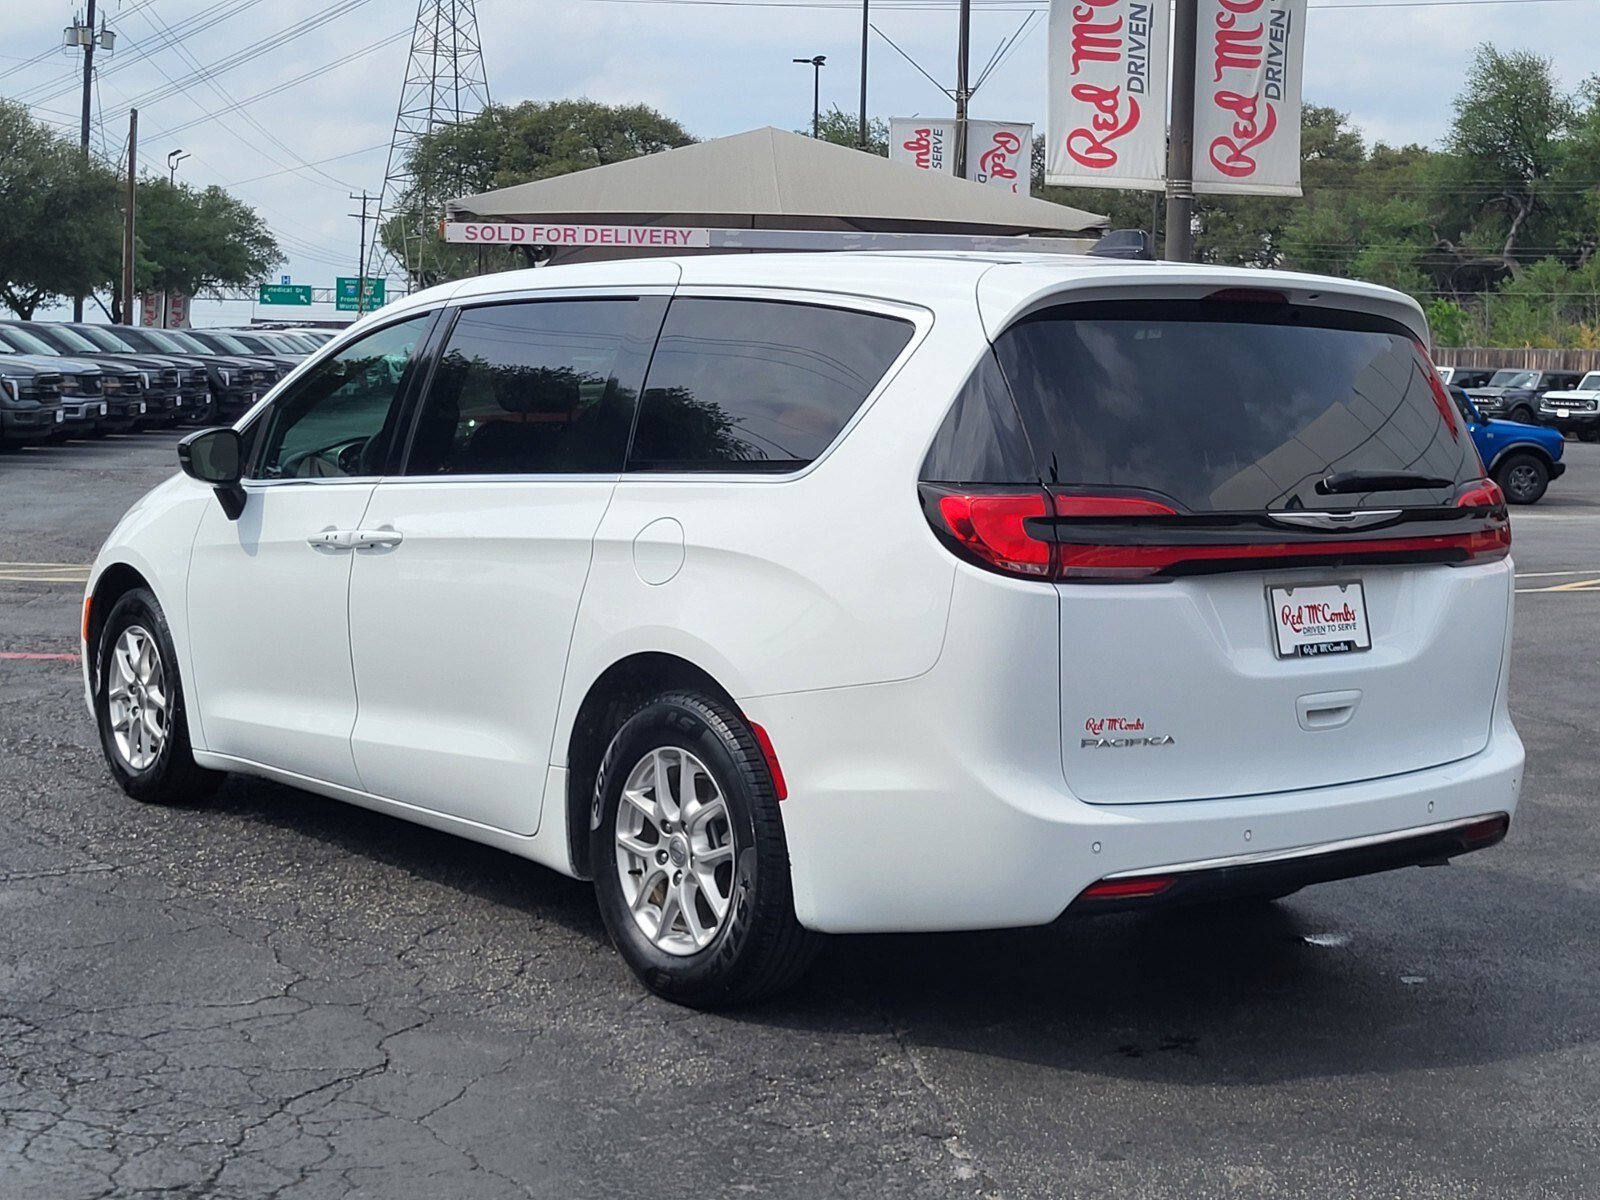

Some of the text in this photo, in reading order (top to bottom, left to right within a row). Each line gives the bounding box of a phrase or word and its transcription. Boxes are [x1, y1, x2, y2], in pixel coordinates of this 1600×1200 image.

[1127, 3, 1148, 94] DRIVEN
[1265, 9, 1286, 101] DRIVEN
[1066, 84, 1140, 169] Red
[1209, 90, 1277, 177] Red
[932, 128, 944, 170] SERVE
[980, 131, 1021, 179] Red
[465, 225, 693, 245] SOLD FOR DELIVERY
[1281, 602, 1356, 633] Red McCombs
[1302, 622, 1357, 635] DRIVEN TO SERVE
[1080, 734, 1176, 749] PACIFICA
[1085, 717, 1145, 735] Red McCombs
